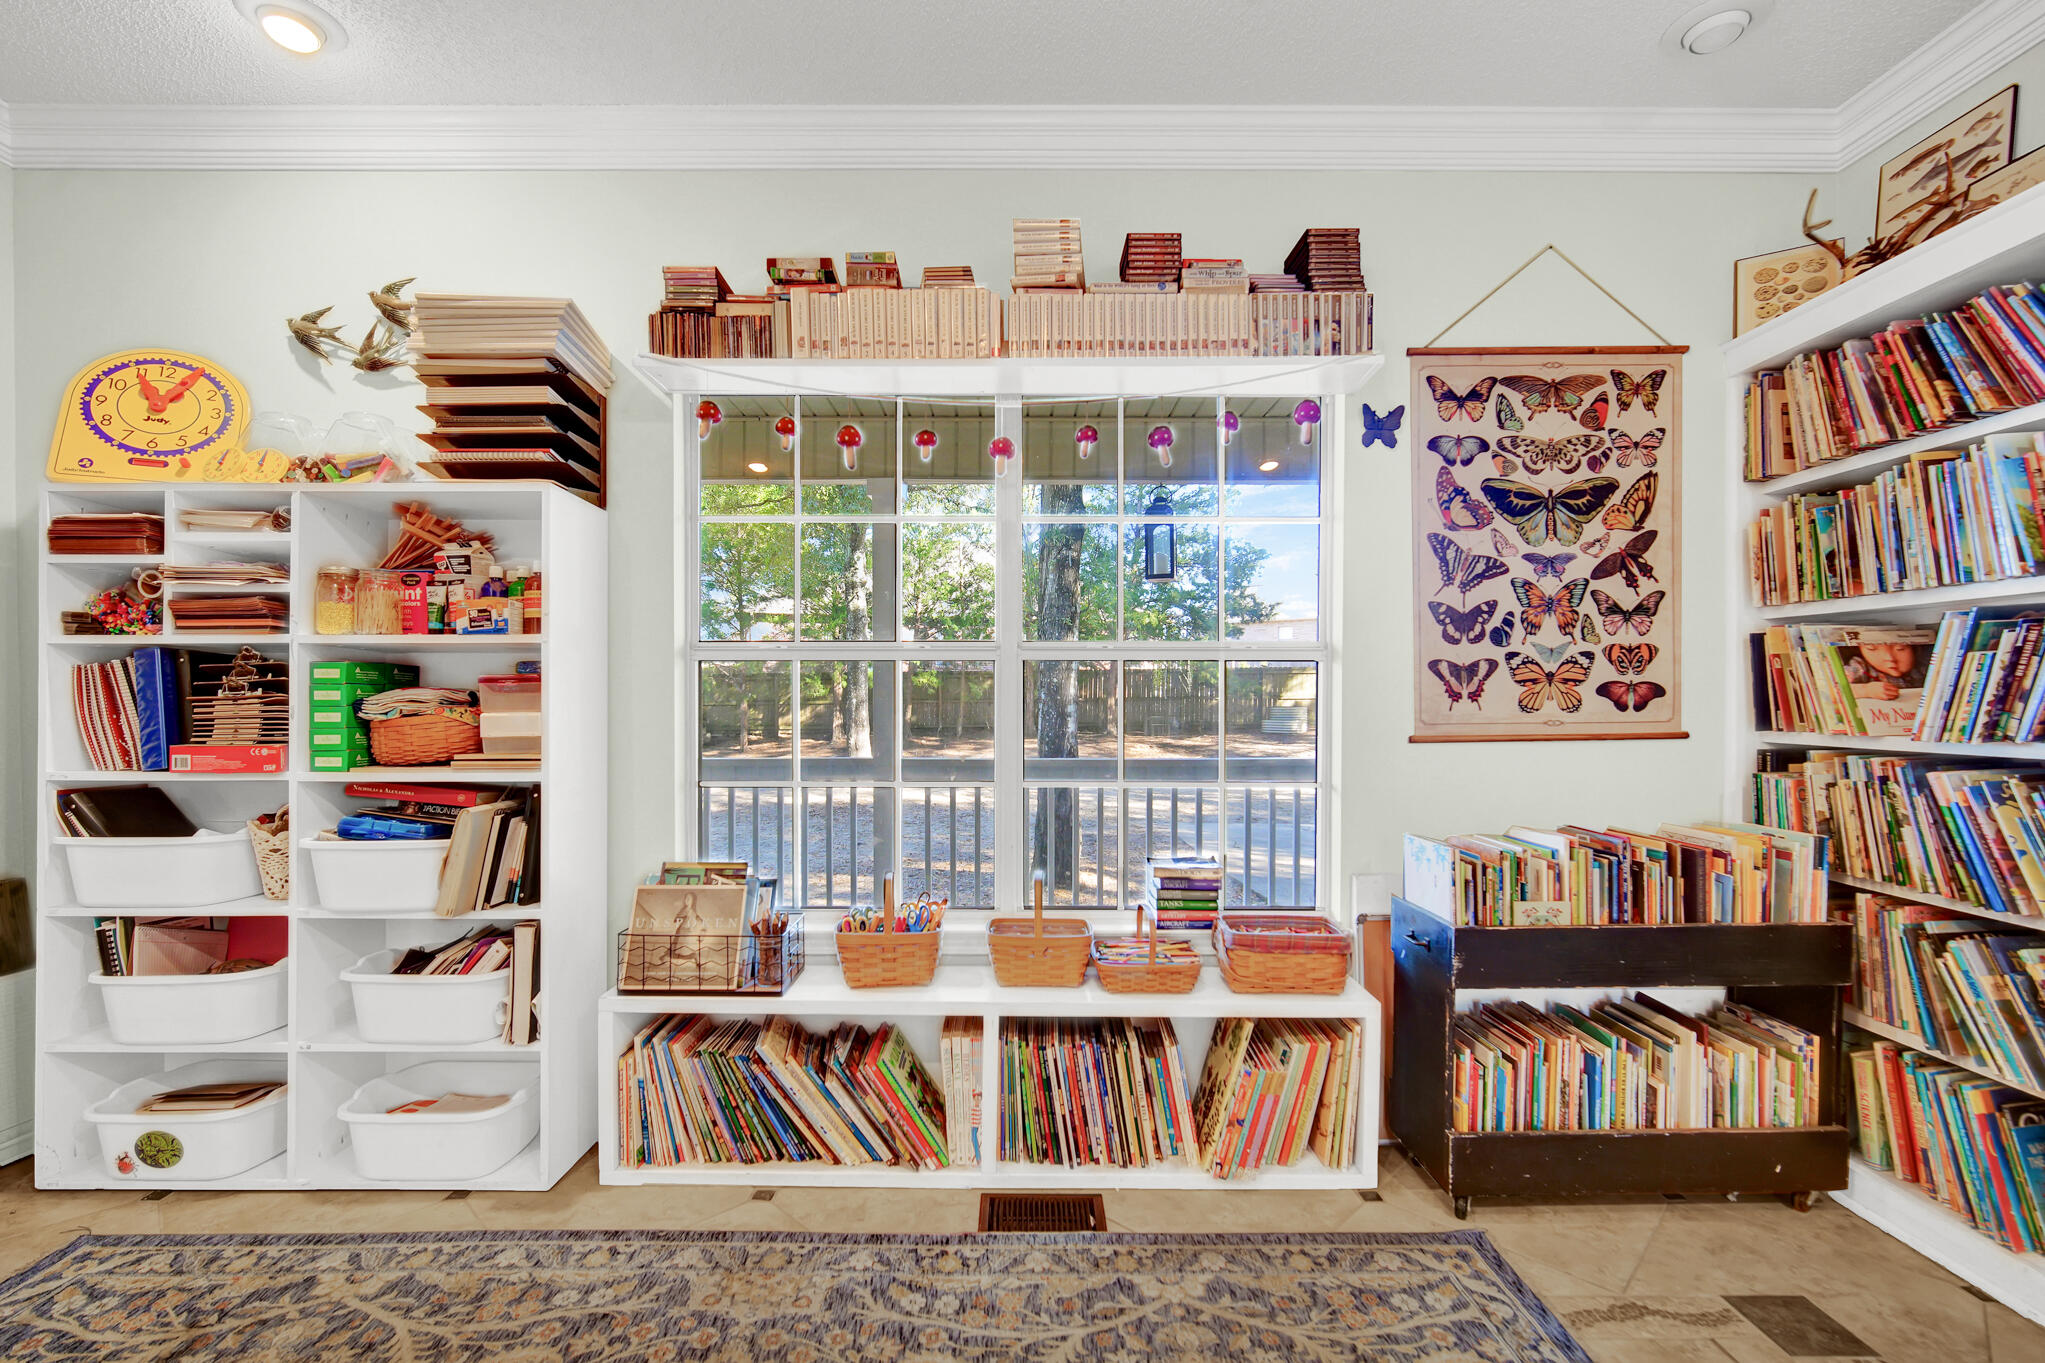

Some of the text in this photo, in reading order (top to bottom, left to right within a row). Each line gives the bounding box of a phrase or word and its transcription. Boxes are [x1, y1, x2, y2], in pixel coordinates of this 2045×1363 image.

[136, 367, 148, 379] 11
[159, 366, 177, 380] 12
[109, 377, 127, 391] 10
[95, 394, 108, 407] 9
[206, 389, 218, 402] 2
[100, 413, 113, 427] 8
[210, 407, 222, 420] 3
[142, 415, 170, 426] Judy
[121, 429, 135, 442] 7
[197, 425, 209, 436] 4
[146, 437, 158, 449] 6
[175, 435, 188, 447] 5
[1869, 708, 1891, 725] My
[1159, 900, 1184, 908] TANKS
[635, 917, 738, 929] UNSPOKEN
[1859, 1092, 1873, 1131] SCIENCE
